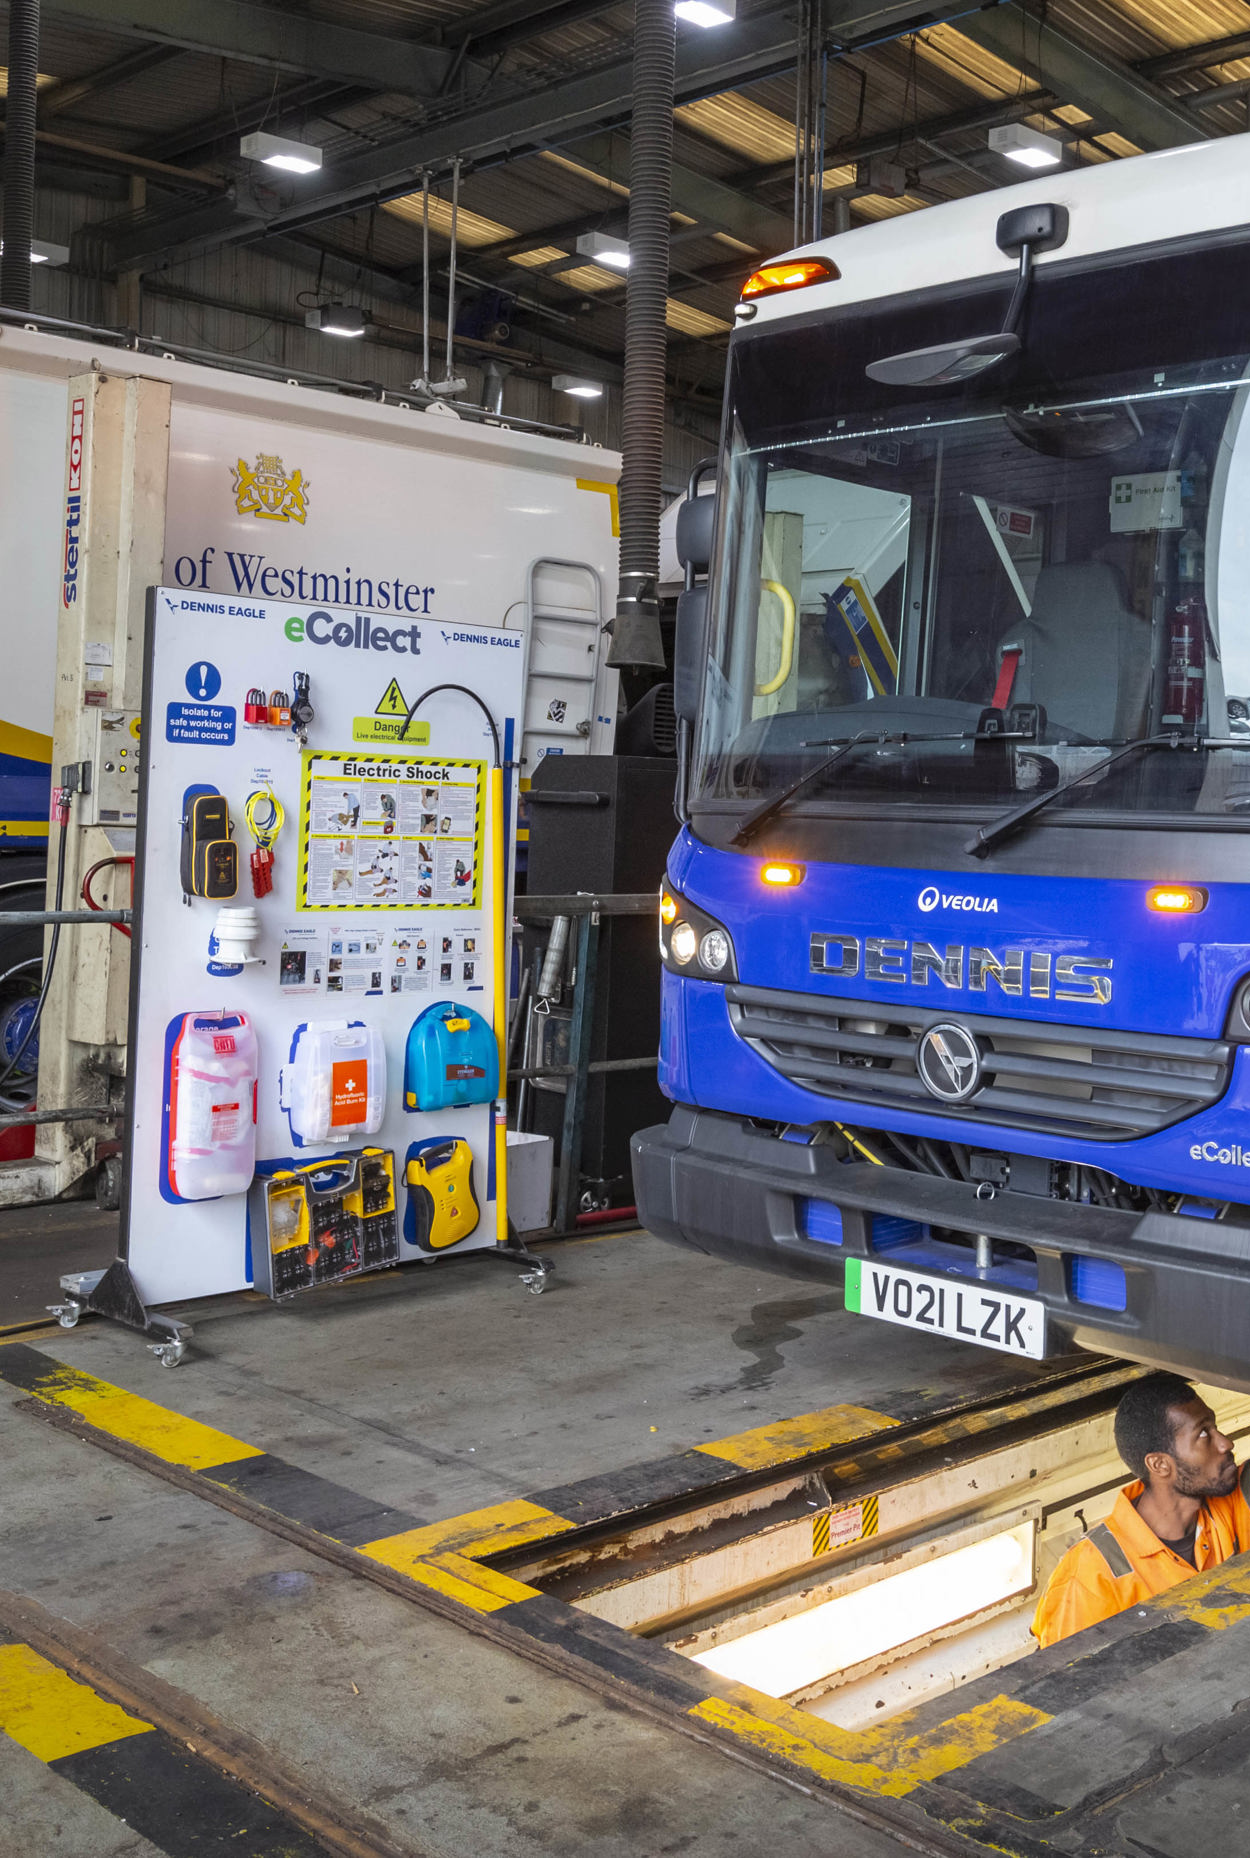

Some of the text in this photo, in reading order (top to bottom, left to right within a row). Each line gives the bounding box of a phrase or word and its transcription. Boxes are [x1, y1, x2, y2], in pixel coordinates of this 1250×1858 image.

[69, 399, 84, 490] KONI
[63, 496, 81, 608] stertil
[174, 547, 435, 614] of Westminster
[180, 600, 266, 619] DENNIS EAGLE
[284, 611, 421, 655] eCollect
[453, 632, 521, 648] DENNIS EAGLE
[181, 707, 223, 718] Isolate for
[169, 718, 187, 727] safe
[189, 719, 222, 730] working
[223, 722, 233, 730] or
[374, 721, 411, 735] Dangr
[172, 728, 229, 740] if fault occurs
[342, 763, 450, 780] Electric Shock
[940, 894, 999, 913] VEOLIA
[809, 932, 1114, 1006] DENNIS
[872, 1271, 1026, 1349] VO21 LZK
